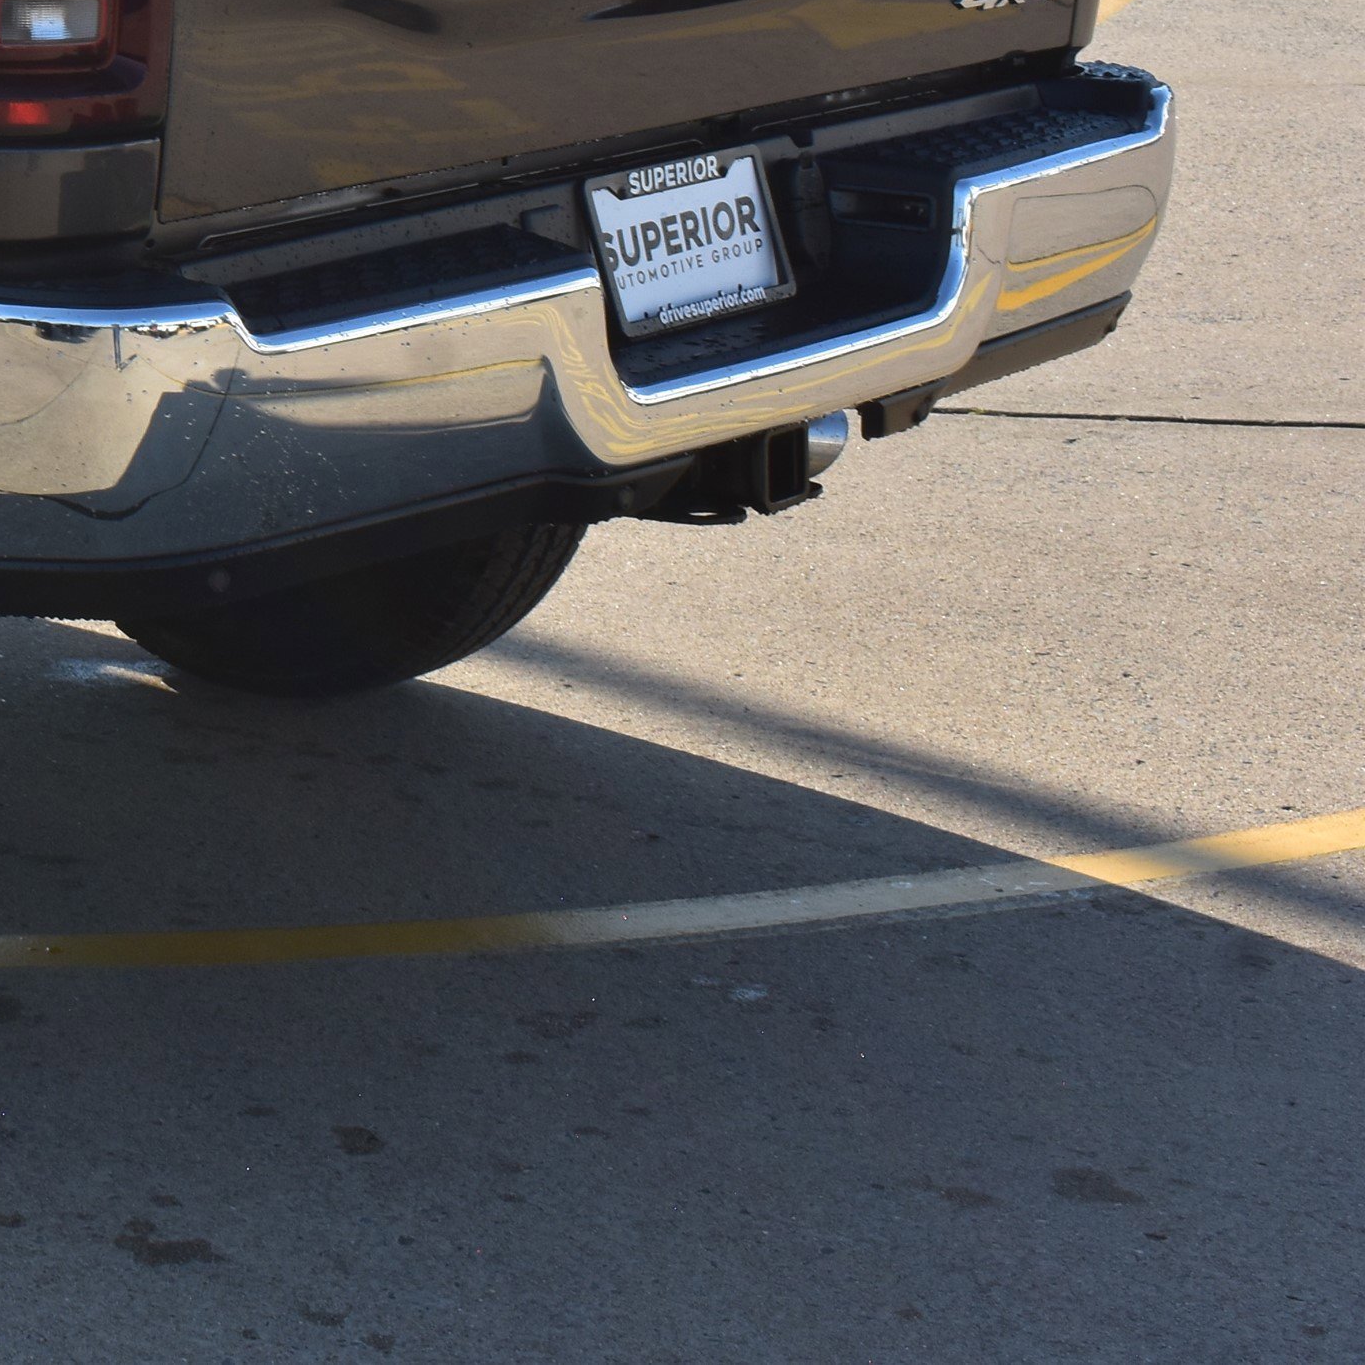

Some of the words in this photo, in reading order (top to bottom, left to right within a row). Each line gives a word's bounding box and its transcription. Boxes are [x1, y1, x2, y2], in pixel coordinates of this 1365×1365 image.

[628, 155, 720, 195] SUPERIOR
[616, 254, 703, 290] UTOMOTIVE
[711, 238, 763, 263] GROUP
[658, 285, 767, 325] drivesuperior.com
